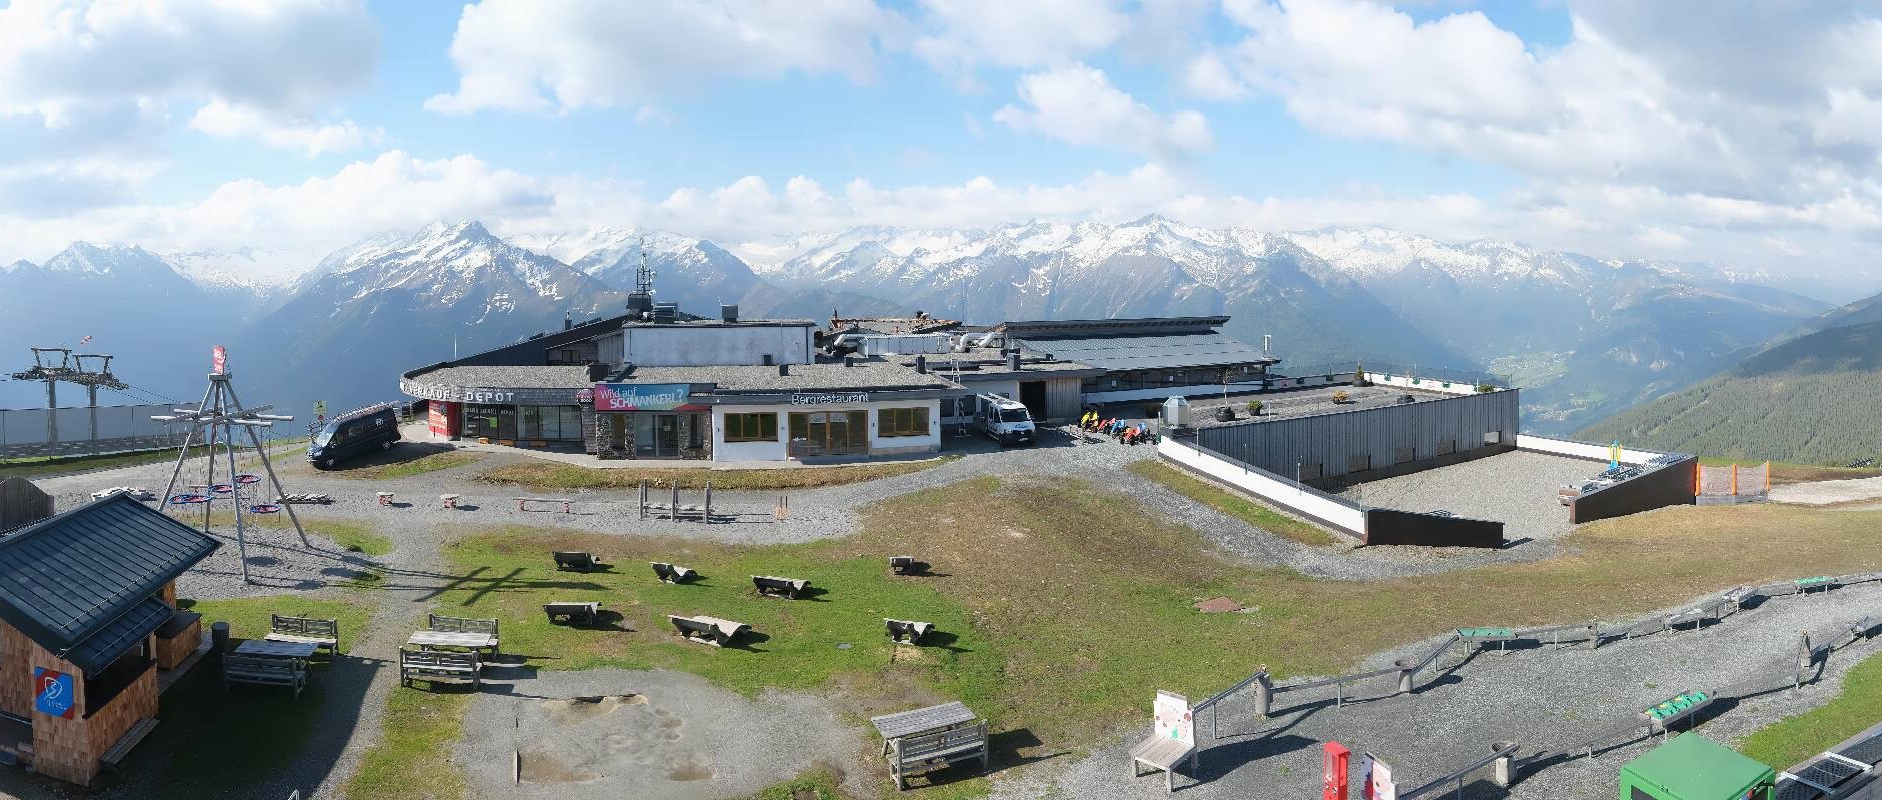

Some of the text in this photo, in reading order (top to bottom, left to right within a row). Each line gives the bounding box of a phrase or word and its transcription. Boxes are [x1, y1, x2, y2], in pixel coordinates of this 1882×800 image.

[465, 392, 515, 402] DEPOT
[600, 386, 637, 400] Wild auf
[609, 388, 684, 409] SCHMANKERL?
[791, 393, 869, 405] Bergrestaurant
